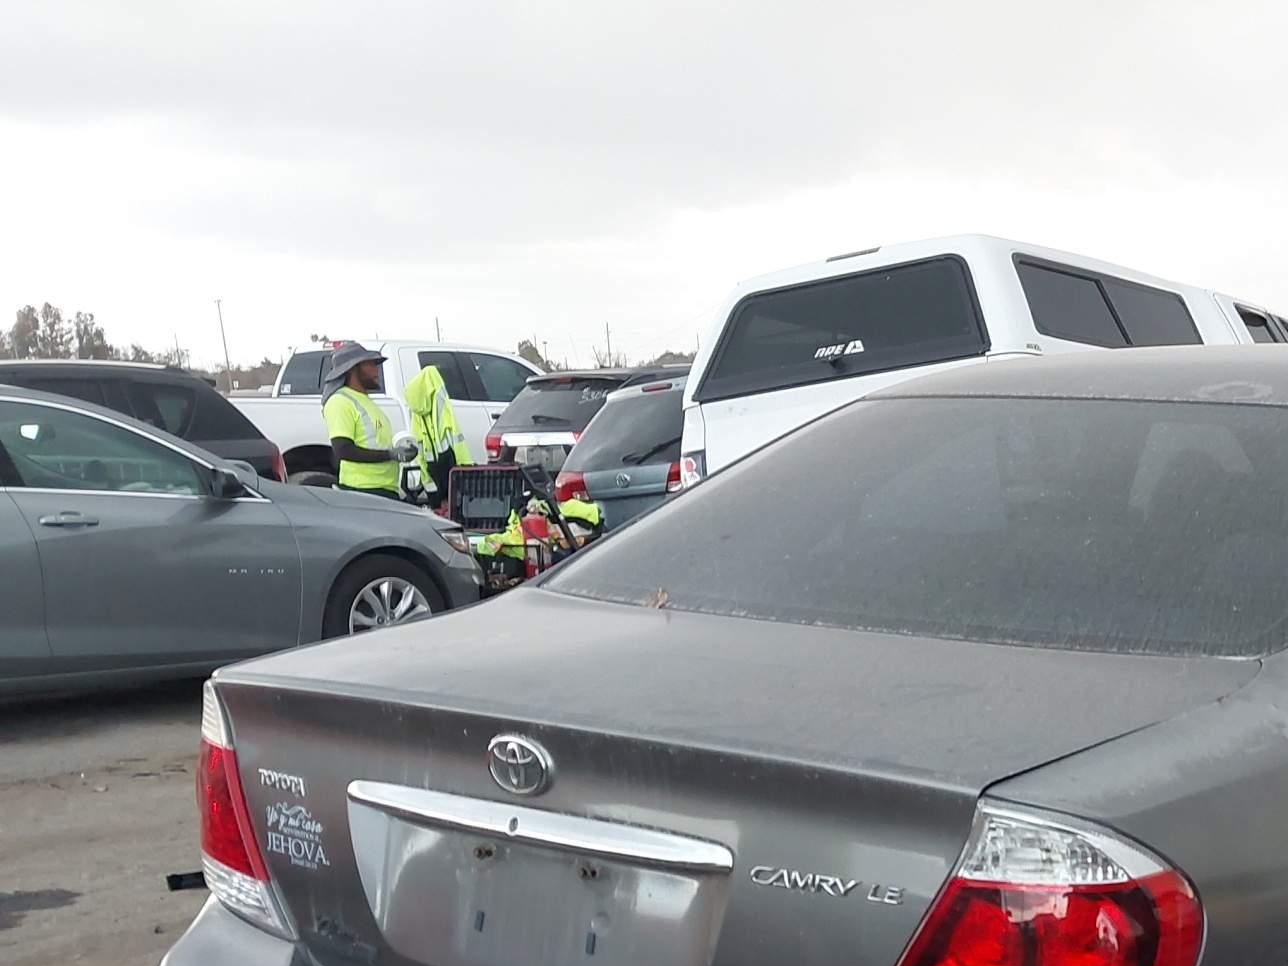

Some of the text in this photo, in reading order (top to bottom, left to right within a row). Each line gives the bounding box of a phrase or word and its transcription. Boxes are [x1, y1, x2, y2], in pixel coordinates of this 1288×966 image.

[258, 768, 305, 797] TOYOTA
[750, 865, 904, 905] CAMRY LE
